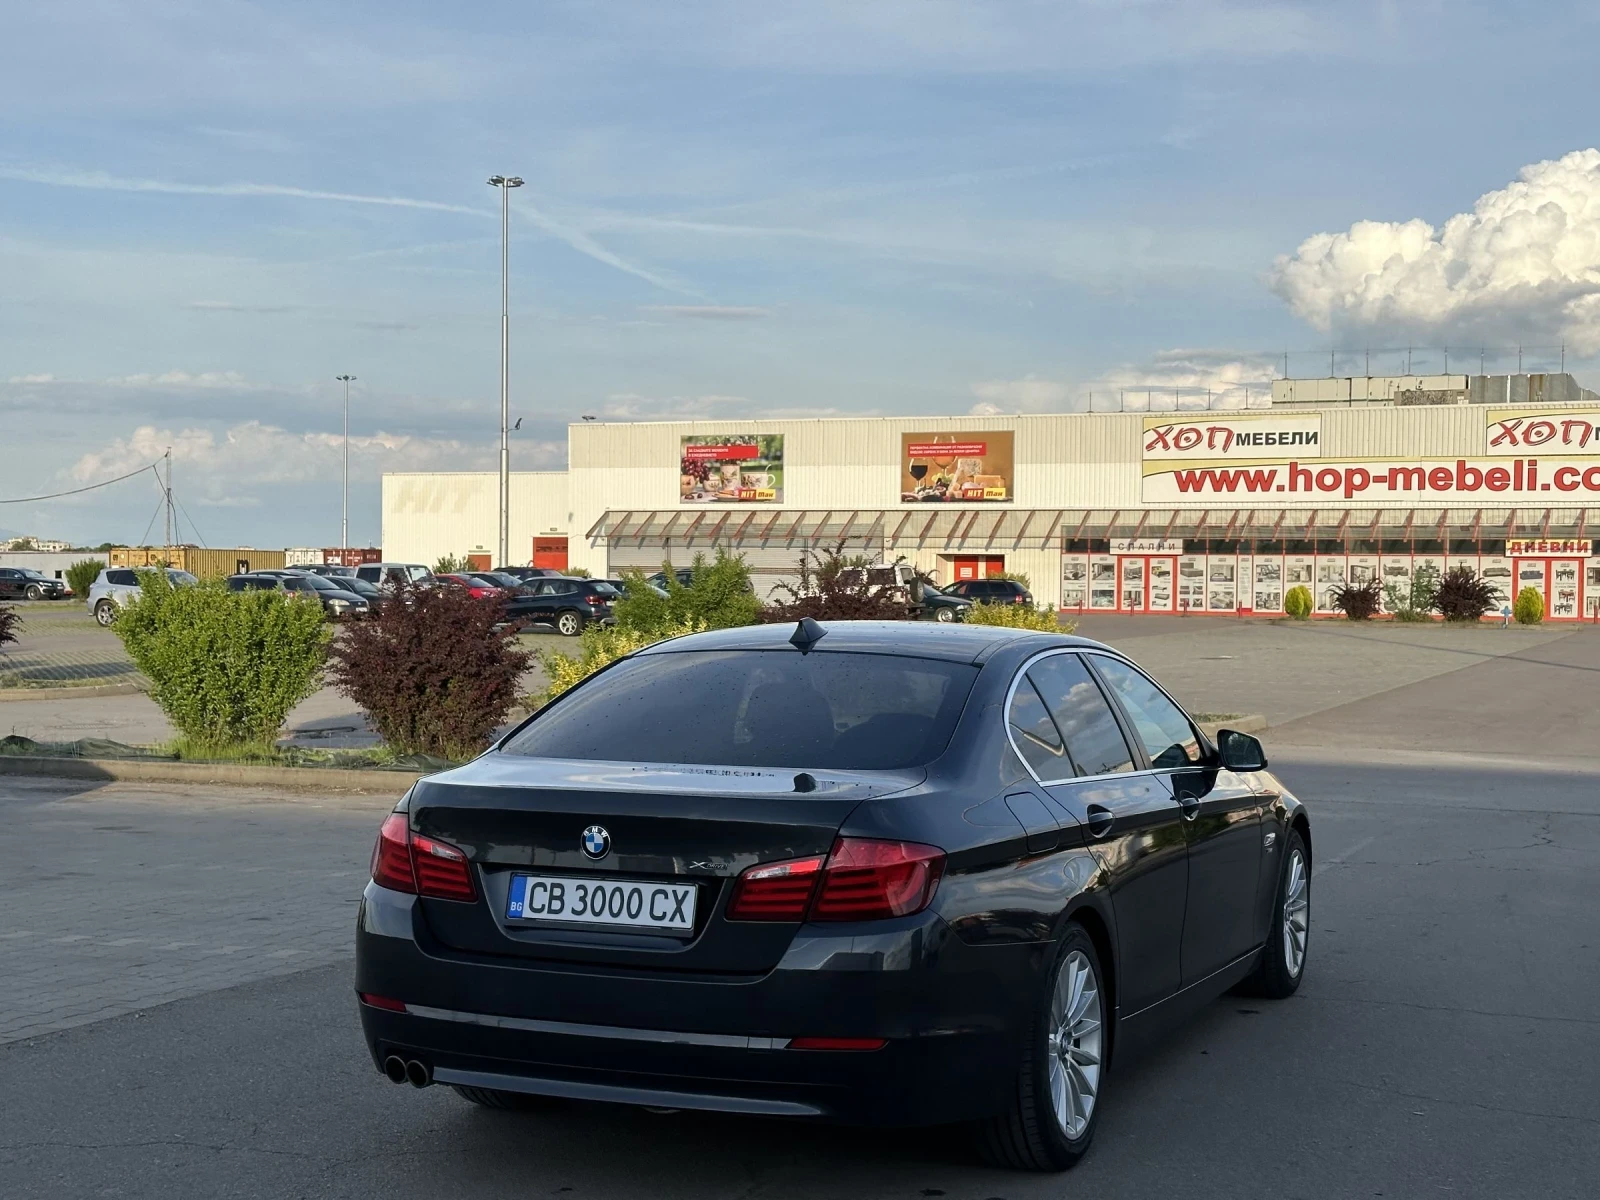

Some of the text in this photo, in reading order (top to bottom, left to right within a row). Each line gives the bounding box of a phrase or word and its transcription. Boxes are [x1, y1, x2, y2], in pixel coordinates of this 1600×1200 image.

[1144, 425, 1319, 453] ХОП МЕБЕЛИ
[1489, 418, 1594, 448] ХОП
[1117, 543, 1176, 551] СПАЛНИ
[1510, 541, 1588, 555] ДНЕВНИ
[510, 901, 523, 912] BG
[529, 881, 690, 923] CB 3000 CX
